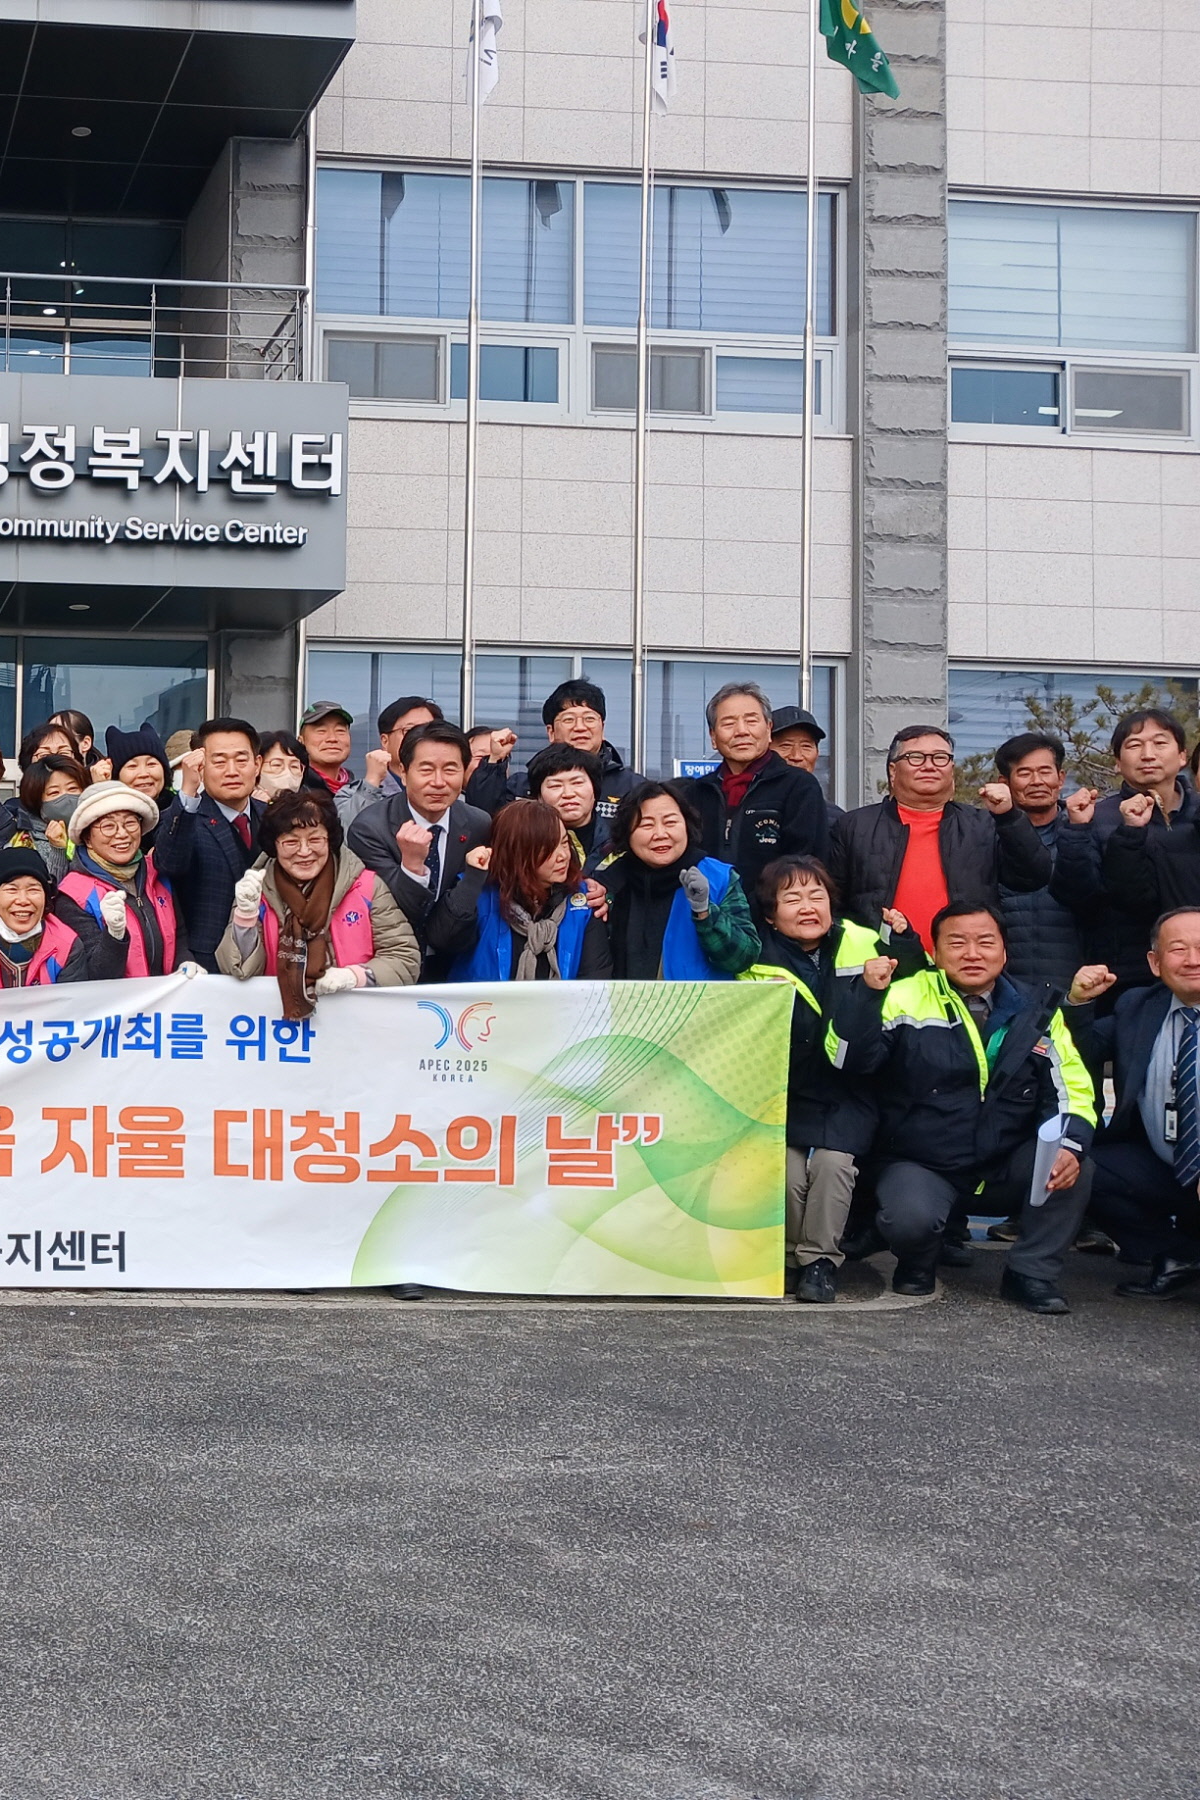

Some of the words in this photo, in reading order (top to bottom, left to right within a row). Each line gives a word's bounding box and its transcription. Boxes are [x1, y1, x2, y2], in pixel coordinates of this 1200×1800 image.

[124, 516, 220, 544] Service
[224, 519, 309, 546] Center
[225, 1014, 316, 1063] 위한
[419, 1059, 450, 1071] APEC
[456, 1060, 488, 1072] 2025
[432, 1074, 474, 1083] KOREA
[41, 1105, 186, 1178] 자율
[213, 1109, 517, 1185] 대청소의
[546, 1115, 663, 1187] 날”
